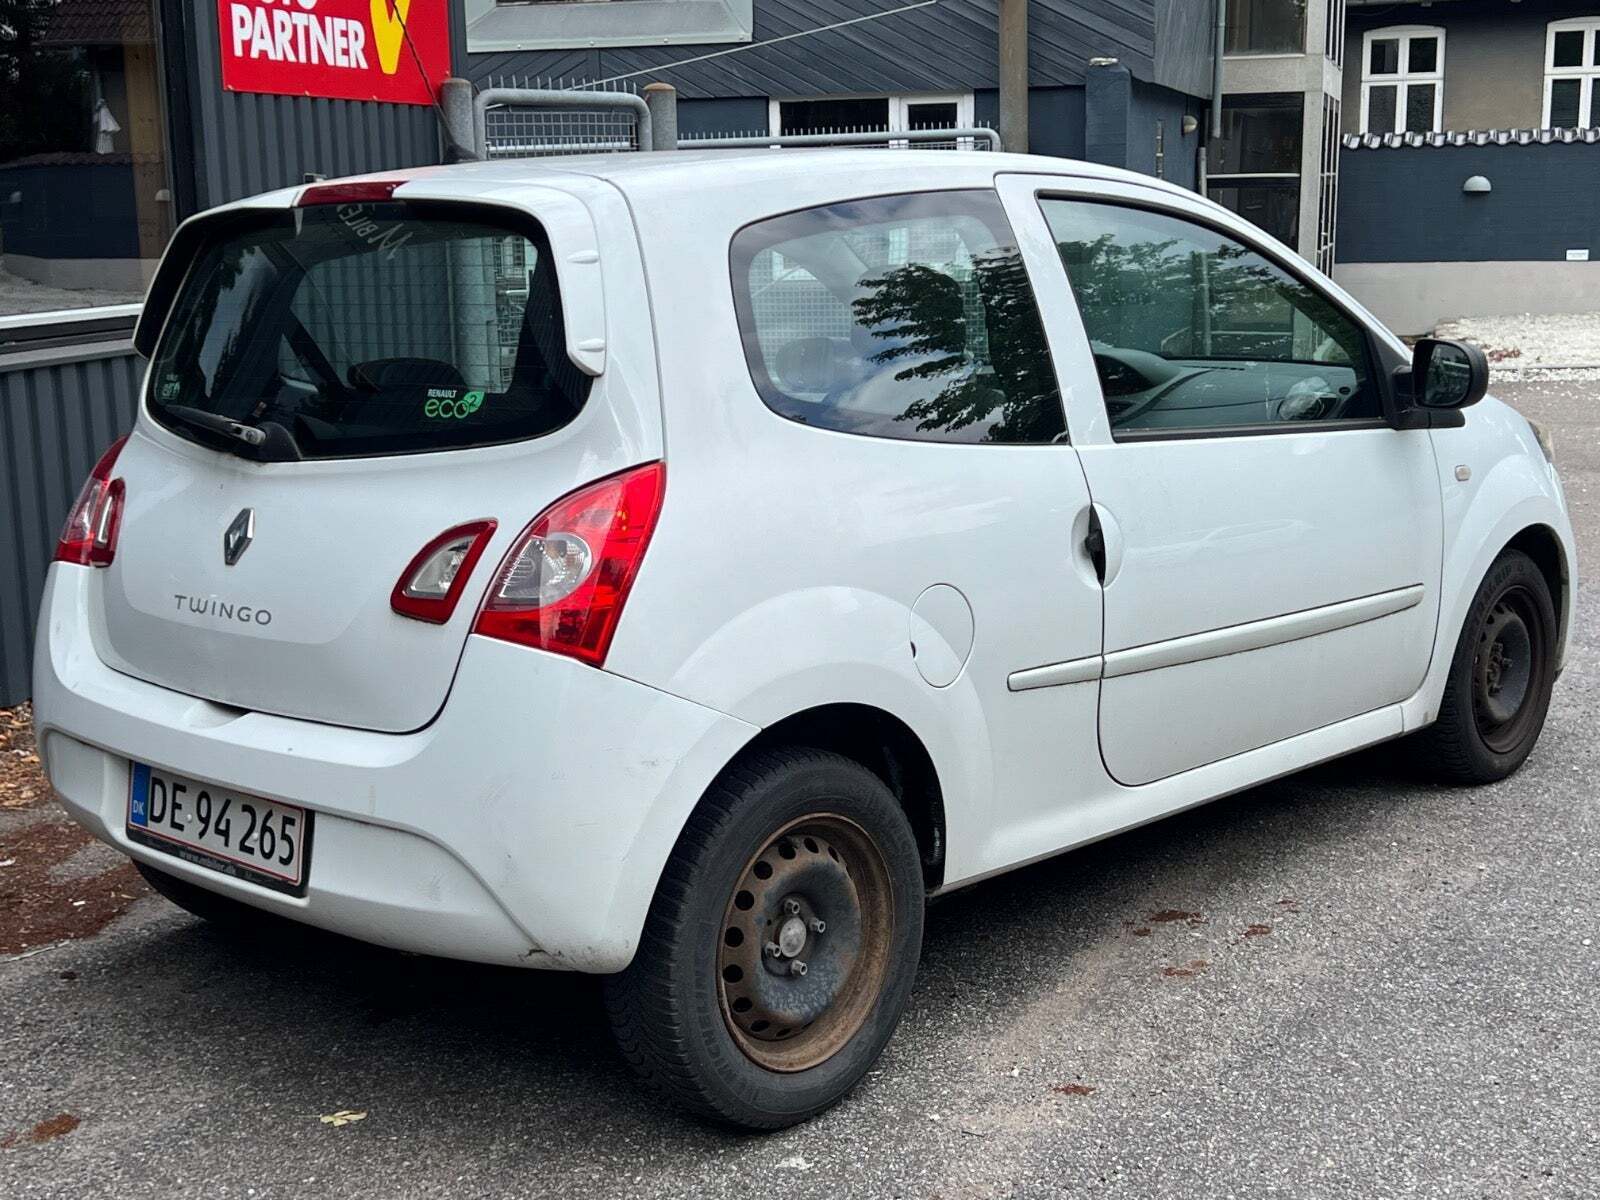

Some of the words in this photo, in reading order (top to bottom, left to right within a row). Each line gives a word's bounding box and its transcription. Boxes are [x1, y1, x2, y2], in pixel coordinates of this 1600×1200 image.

[230, 2, 369, 70] PARTNER
[427, 388, 457, 398] RENAULT
[174, 594, 272, 625] TWINGO
[132, 799, 145, 816] DK
[149, 776, 187, 832] DE
[239, 804, 296, 867] 265
